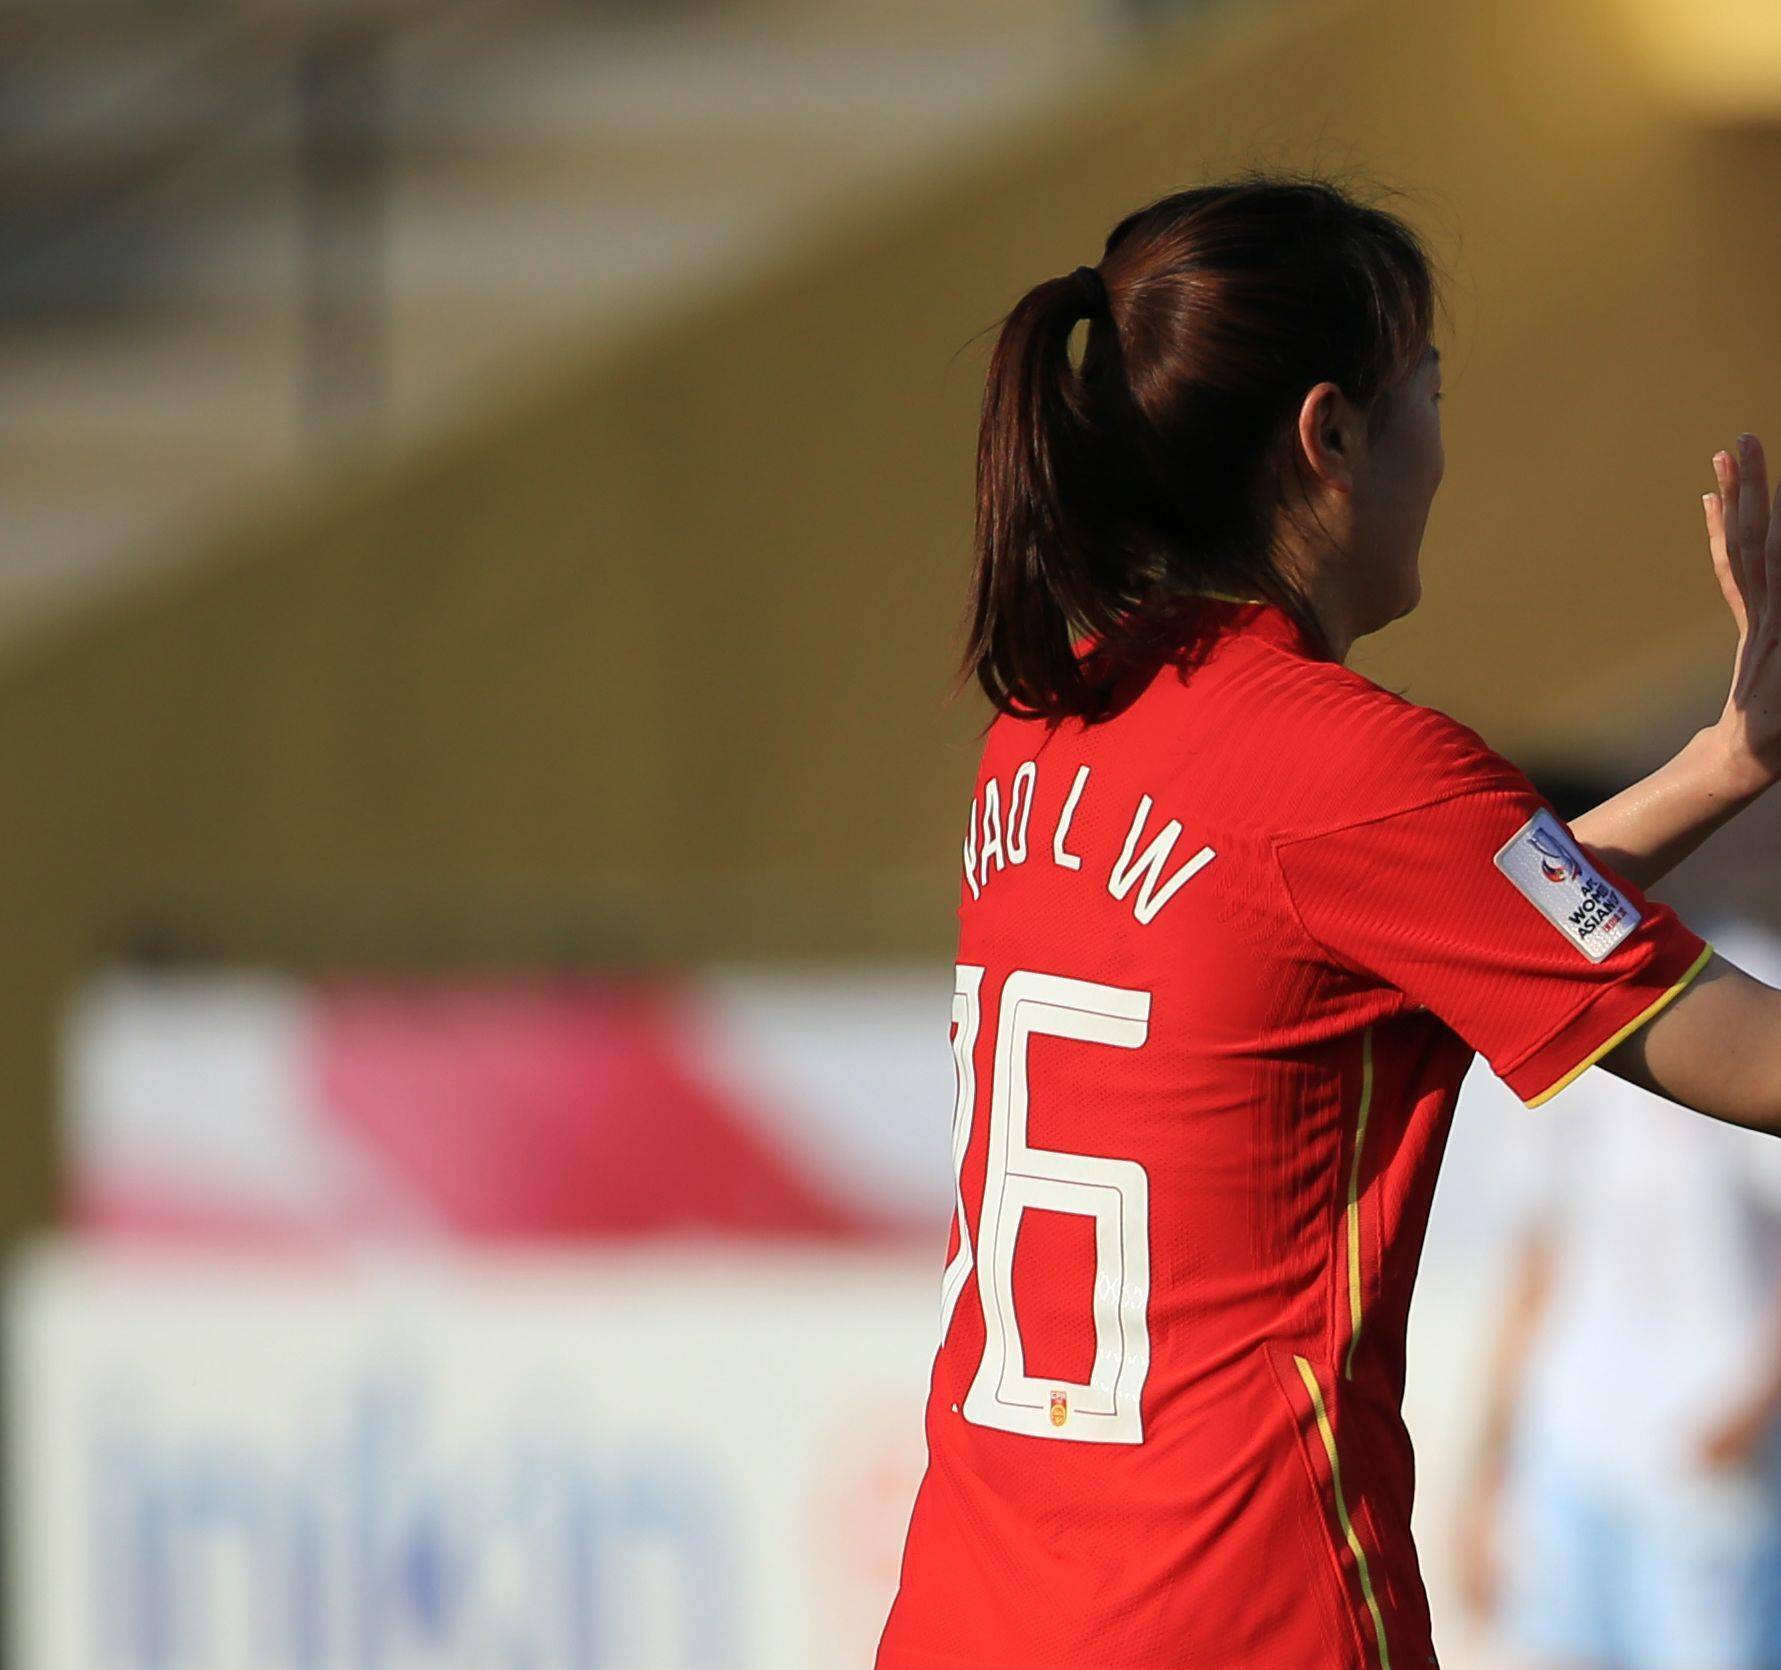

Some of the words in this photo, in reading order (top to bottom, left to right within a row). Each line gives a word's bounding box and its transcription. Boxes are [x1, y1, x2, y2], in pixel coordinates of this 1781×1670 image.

[1053, 763, 1092, 872] L
[1107, 793, 1218, 926] W
[940, 963, 1152, 1445] 16
